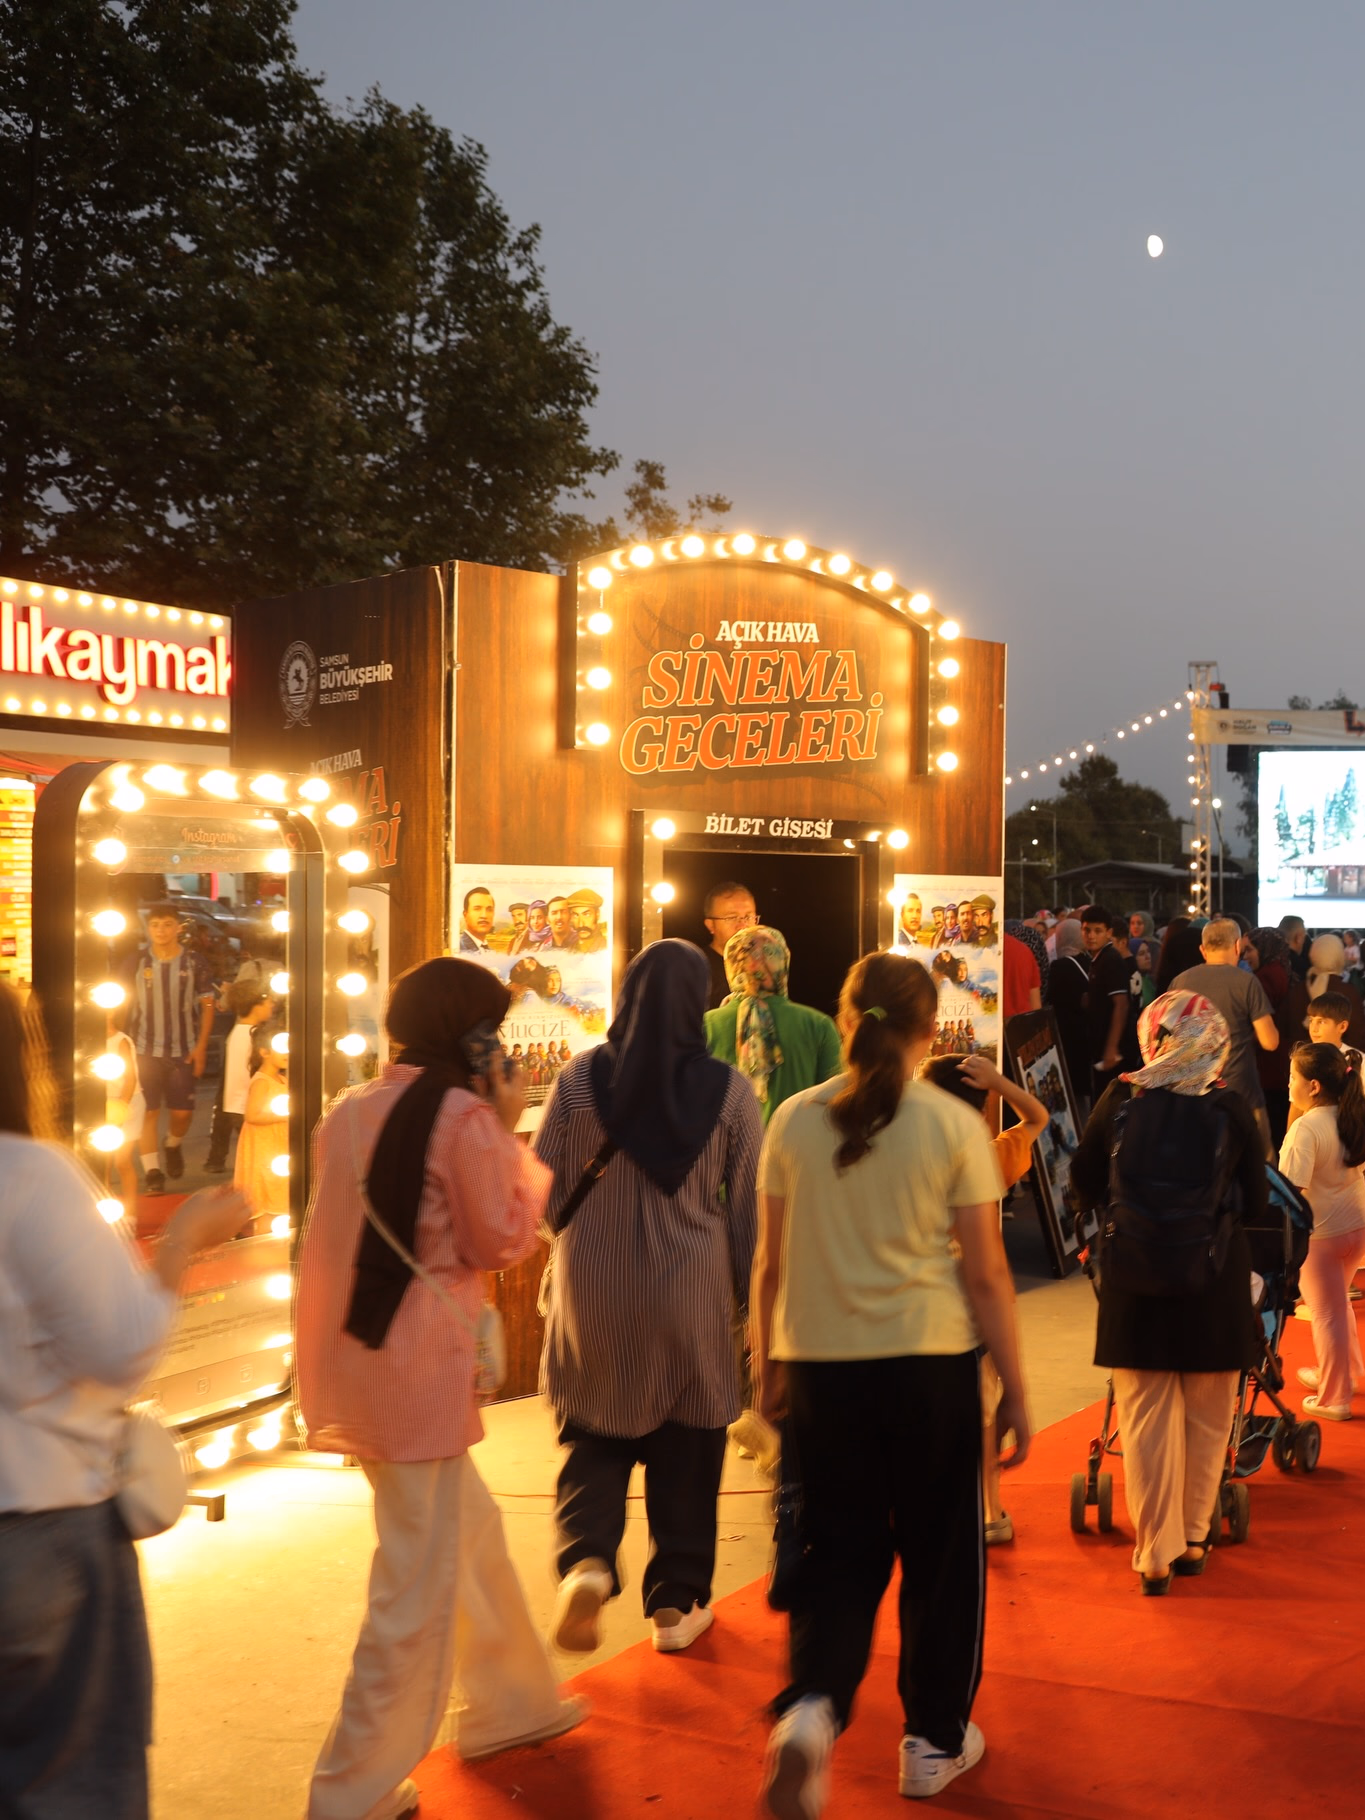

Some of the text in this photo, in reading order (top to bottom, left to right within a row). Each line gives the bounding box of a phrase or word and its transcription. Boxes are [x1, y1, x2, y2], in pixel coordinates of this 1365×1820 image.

[715, 620, 820, 649] AÇIK HAVA
[320, 653, 349, 668] SAMSUN
[642, 632, 863, 709] SİNEMA
[320, 660, 393, 690] BÜYÜKŞEHİR
[320, 687, 360, 704] BELEDİYESİ
[619, 692, 884, 776] GECELERİ
[334, 749, 363, 773] HAVA
[704, 812, 765, 836] BİLET
[181, 827, 238, 849] Instagram
